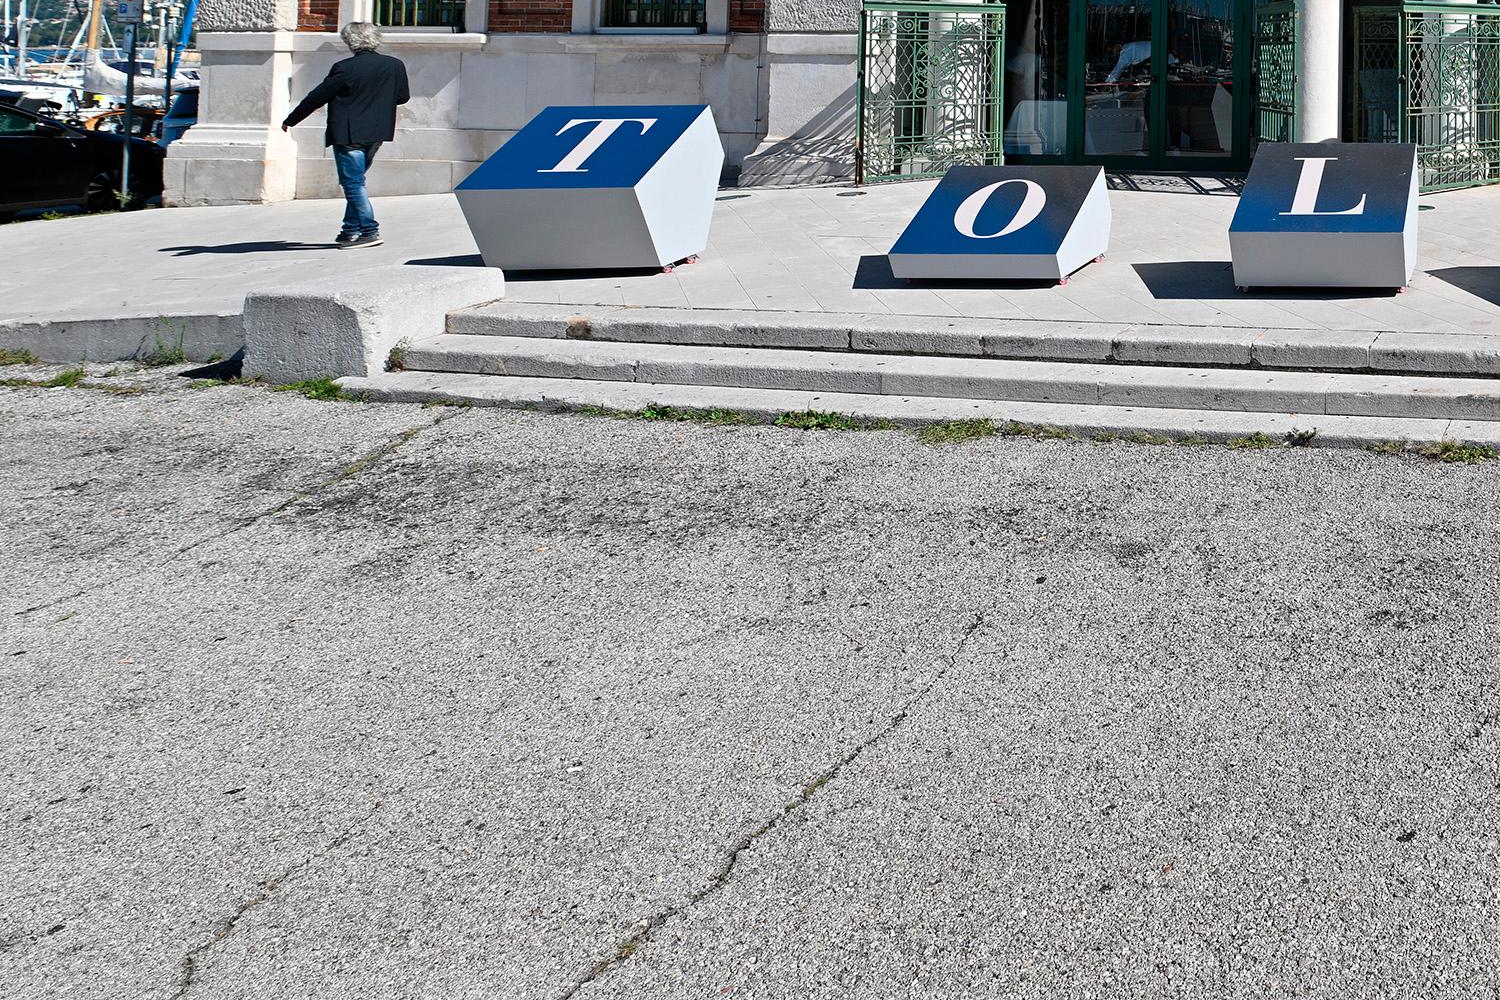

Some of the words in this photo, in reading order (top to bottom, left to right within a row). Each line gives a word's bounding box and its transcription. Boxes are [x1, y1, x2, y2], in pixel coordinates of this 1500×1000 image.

[537, 118, 658, 174] T
[953, 179, 1047, 239] O
[1278, 157, 1367, 216] L
